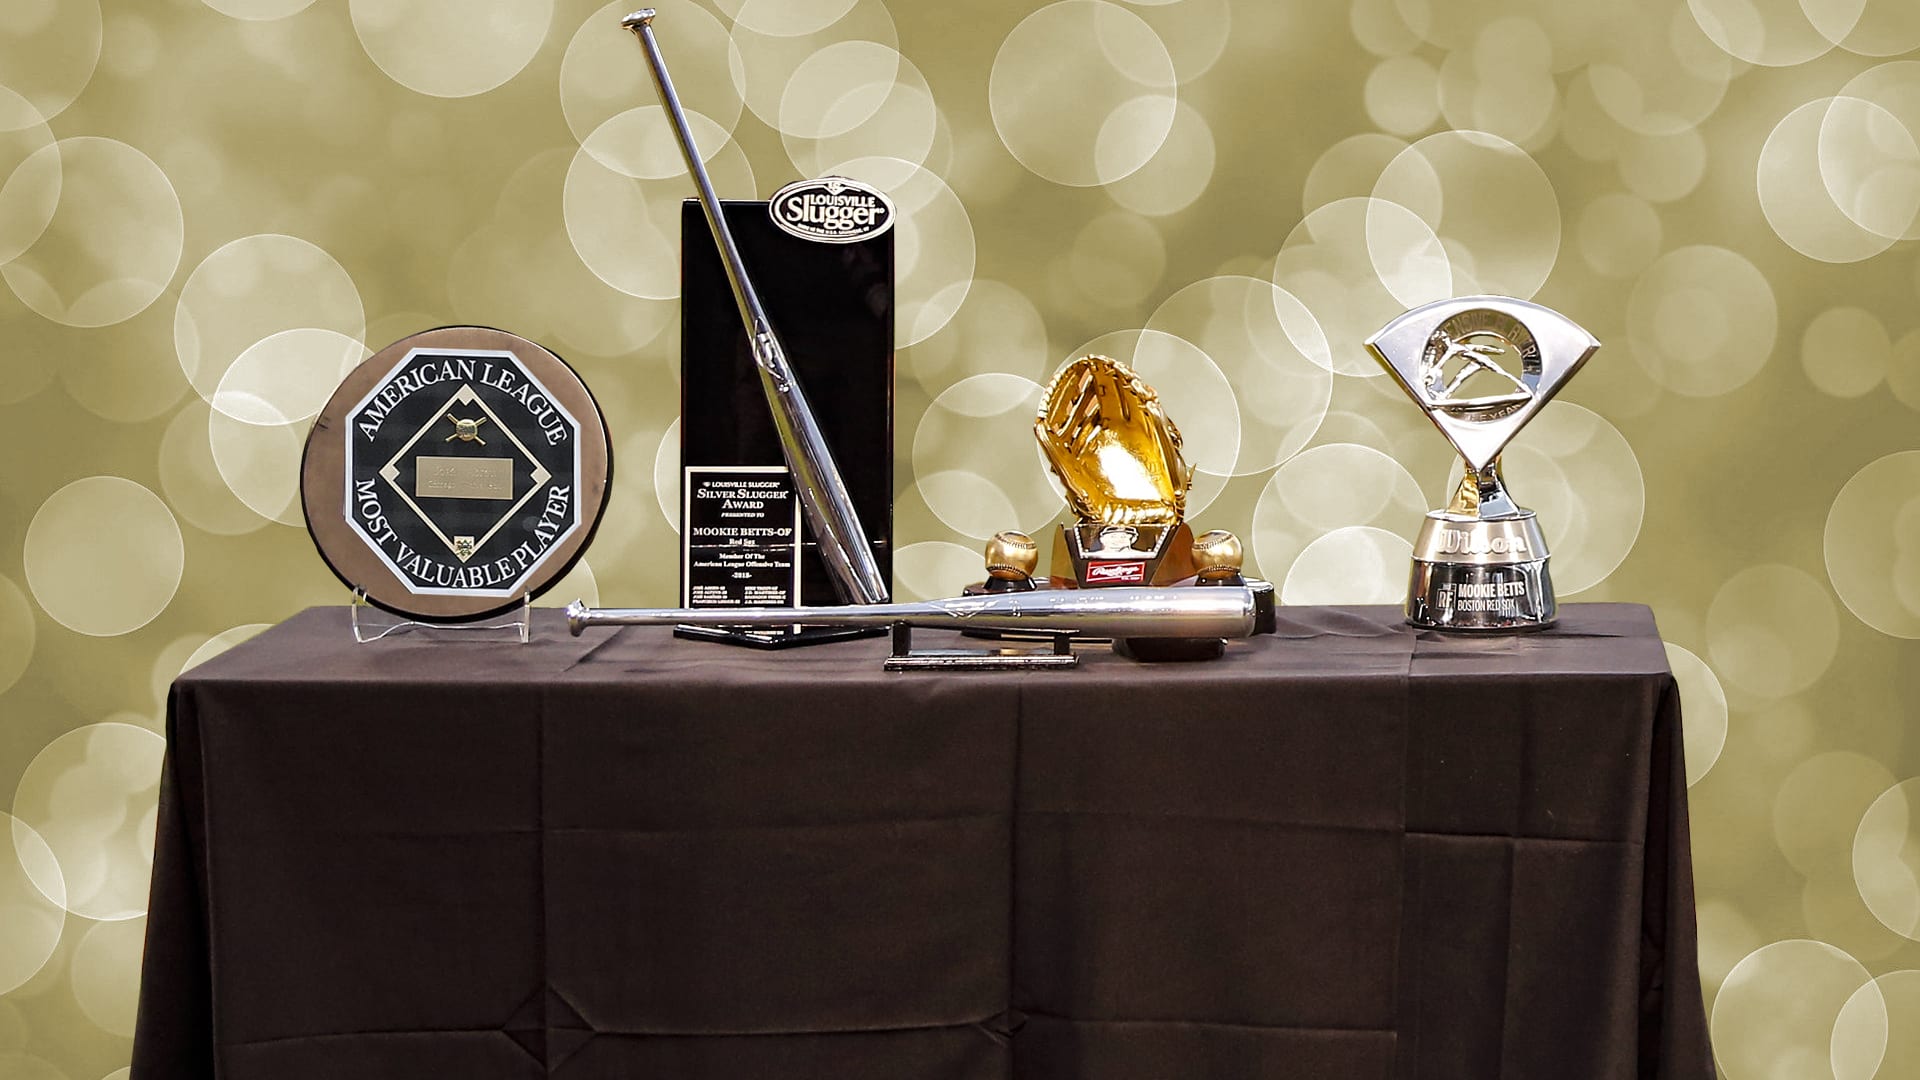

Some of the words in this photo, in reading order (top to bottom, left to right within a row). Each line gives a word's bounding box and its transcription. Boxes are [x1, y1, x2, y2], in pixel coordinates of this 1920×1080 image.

[810, 194, 876, 207] LOUISVILLE
[357, 359, 475, 442] AMERICAN
[480, 362, 568, 446] LEAGUE
[697, 488, 735, 499] SILVER
[722, 499, 764, 509] AWARD
[355, 478, 398, 547] MOST
[394, 541, 517, 588] VALUABLE
[511, 484, 571, 571] PLAYER
[693, 527, 738, 536] MOOKIE
[741, 527, 792, 536] BETTS-OF
[1438, 529, 1527, 554] Wion
[1458, 583, 1496, 598] MOOKIE
[1497, 581, 1525, 597] BETTS
[1438, 591, 1454, 608] RF
[1457, 600, 1486, 612] BOSTON
[1486, 600, 1500, 611] RED
[1501, 599, 1515, 610] SOX
